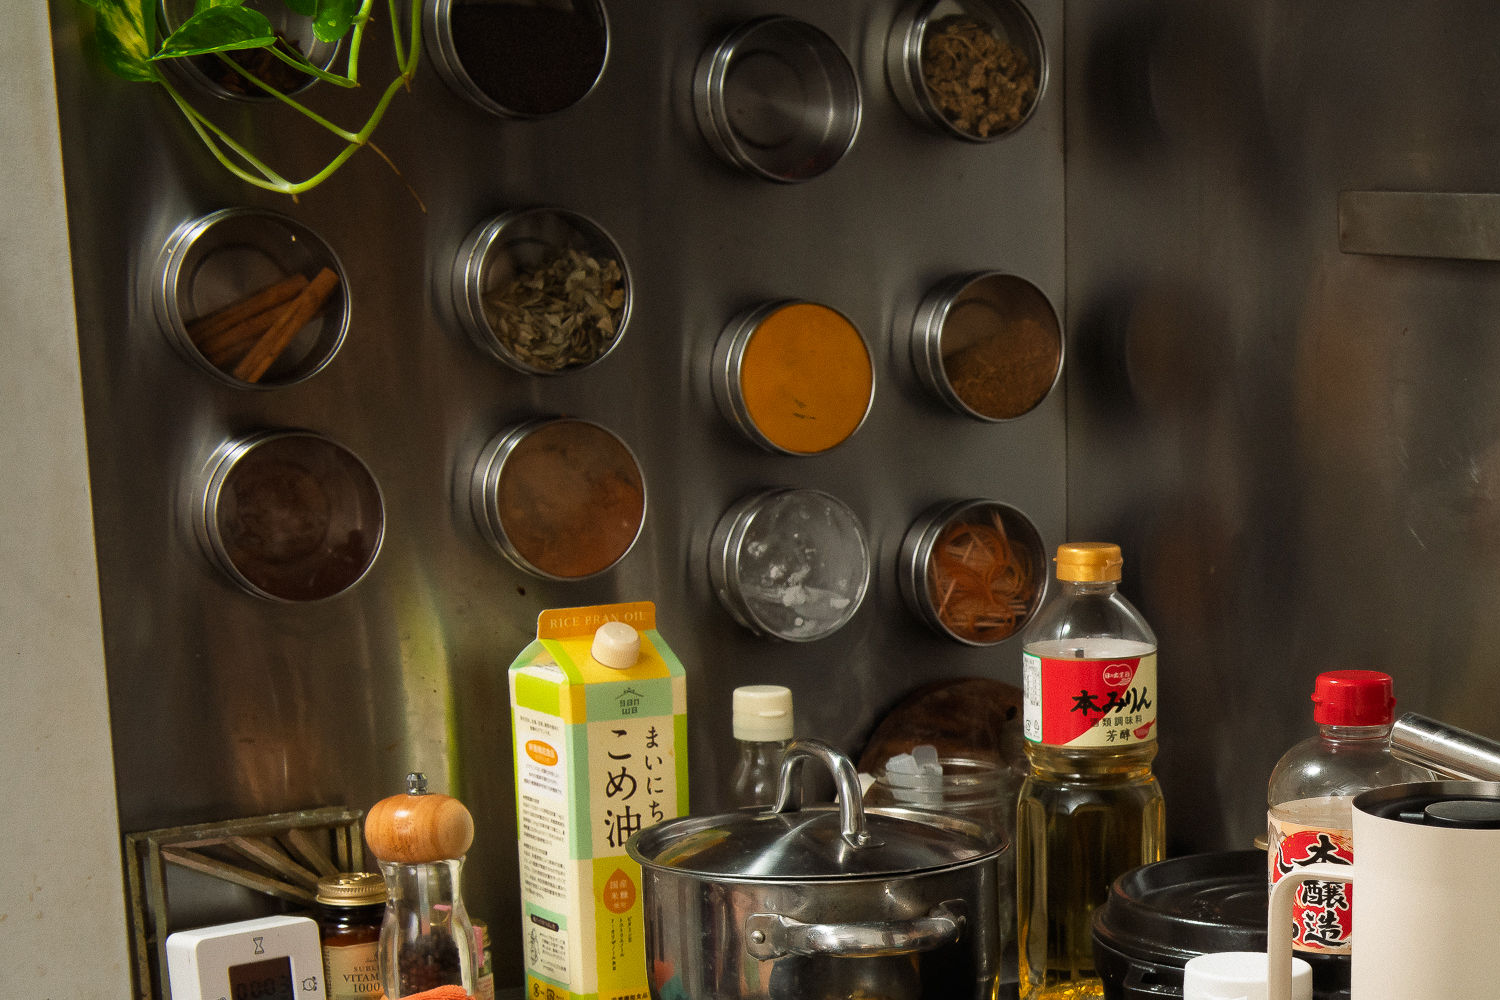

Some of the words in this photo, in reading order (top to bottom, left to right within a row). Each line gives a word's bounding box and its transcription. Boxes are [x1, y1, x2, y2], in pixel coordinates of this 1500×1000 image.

[550, 617, 580, 629] RICE
[624, 611, 648, 622] OIL
[1070, 686, 1152, 717] 本みりん
[604, 729, 642, 848] こめ油
[645, 726, 664, 823] まいにち
[343, 973, 380, 984] VITAM
